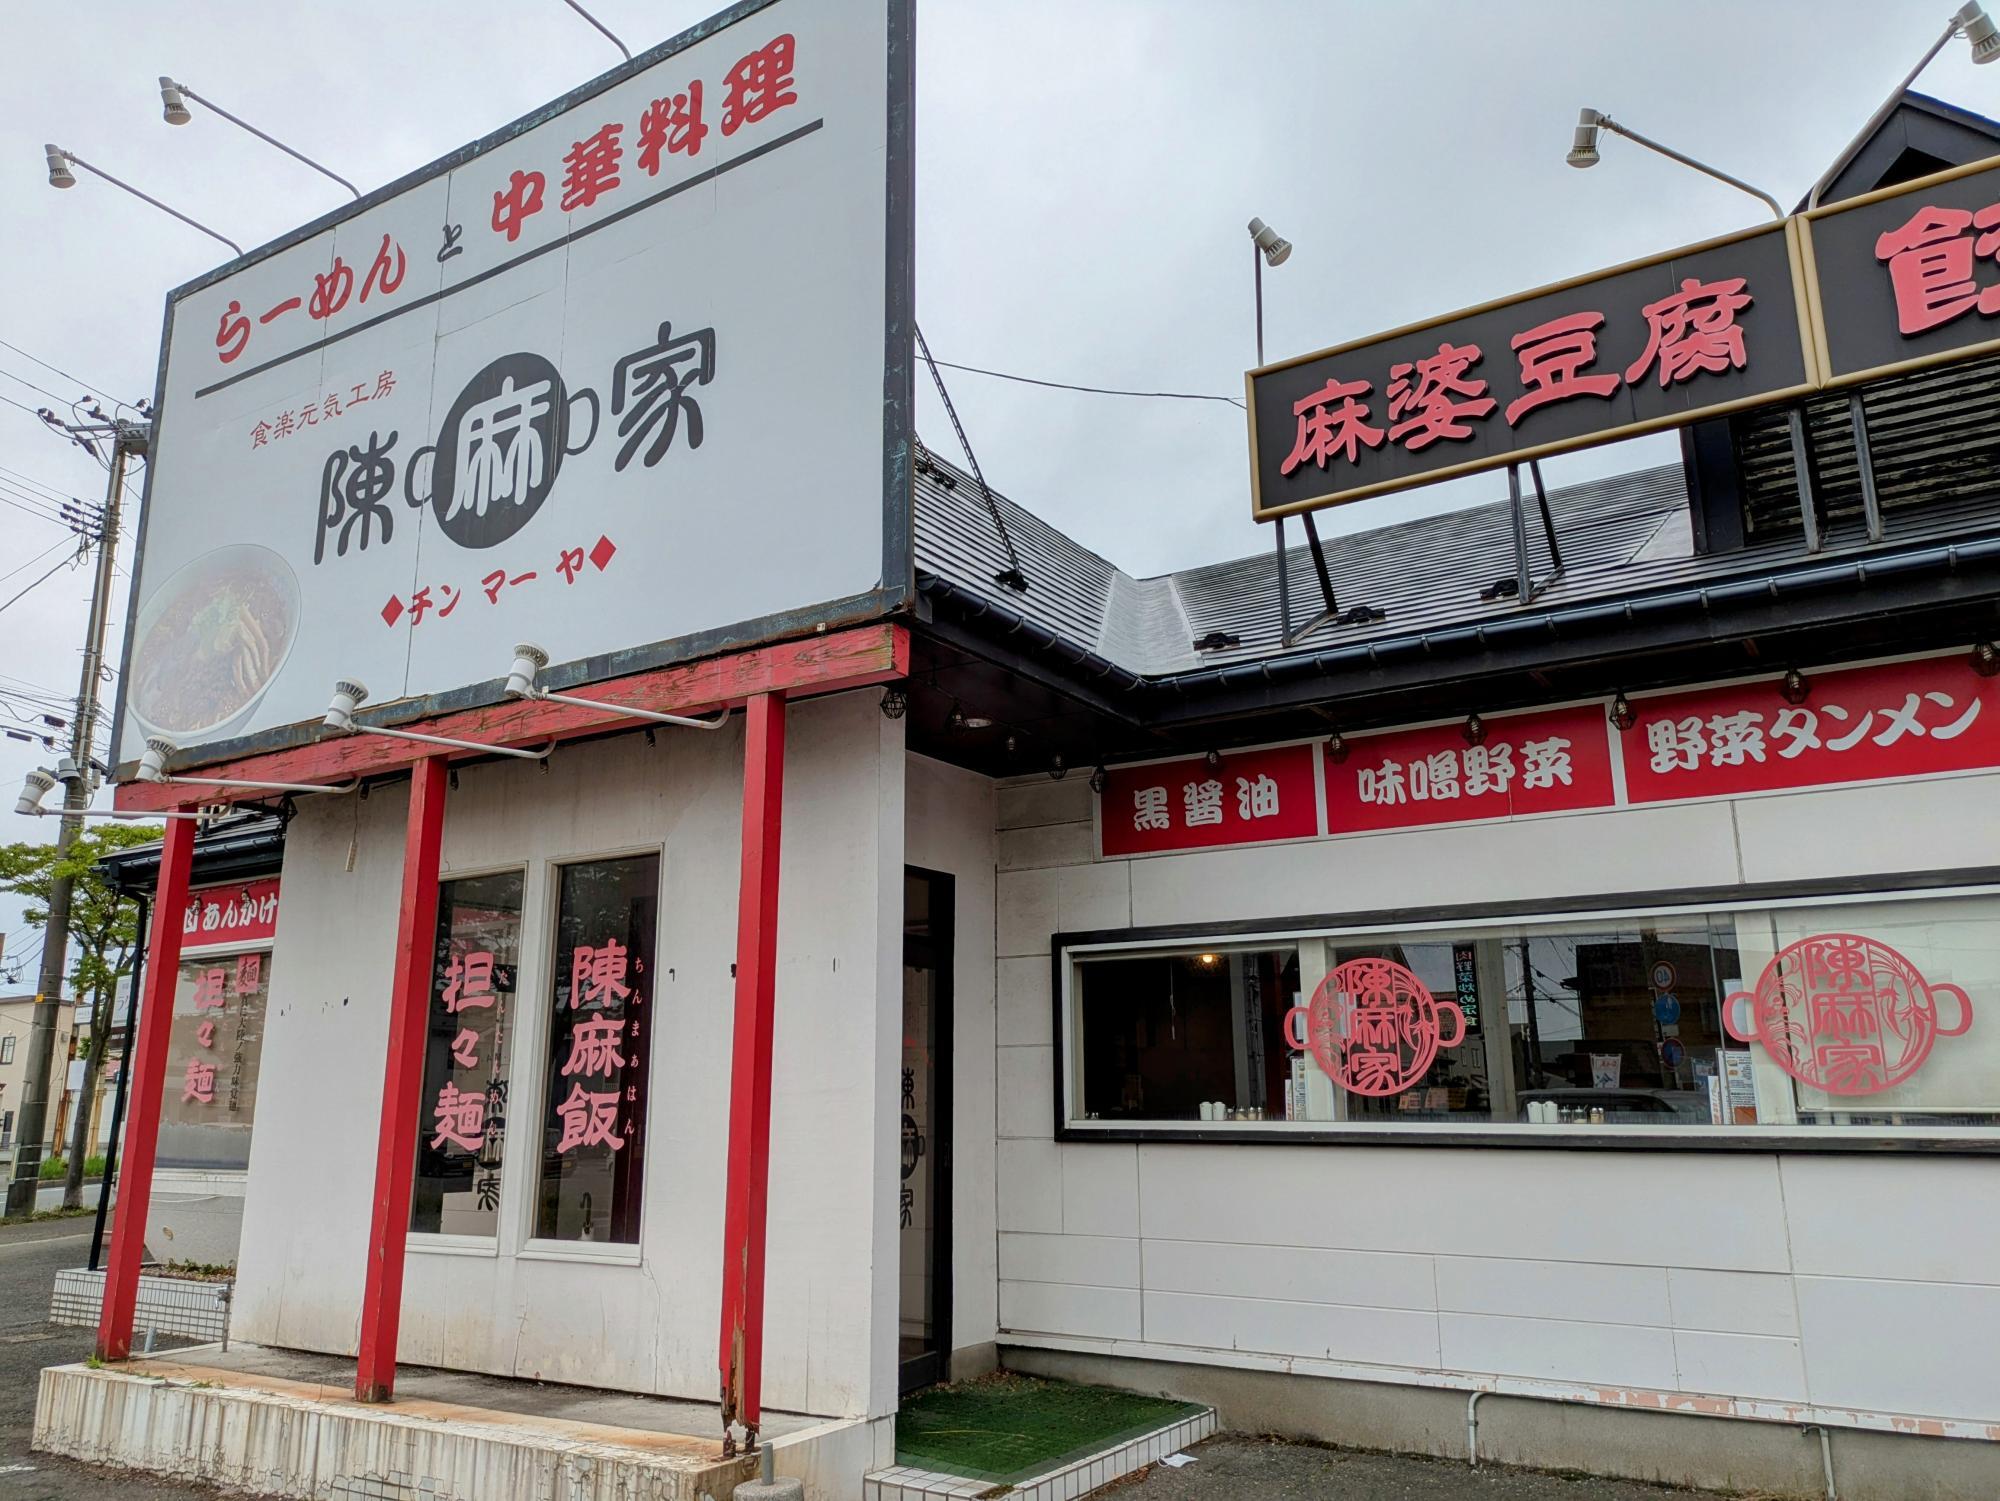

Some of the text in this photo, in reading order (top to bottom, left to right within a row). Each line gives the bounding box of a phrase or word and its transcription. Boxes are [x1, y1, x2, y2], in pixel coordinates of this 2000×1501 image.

[250, 370, 396, 450] 食楽元気工房
[1280, 278, 1753, 477] 麻婆豆腐
[313, 321, 716, 566] 陳麻家
[409, 547, 587, 627] チンマーヤ
[1358, 736, 1573, 805] 味噌野菜
[1647, 691, 1982, 774] 野菜タンメン
[1134, 773, 1280, 831] 黒醤油
[430, 951, 497, 1151] 担々麺
[557, 937, 631, 1154] 陳麻飯
[624, 957, 644, 1135] ちんまあはん
